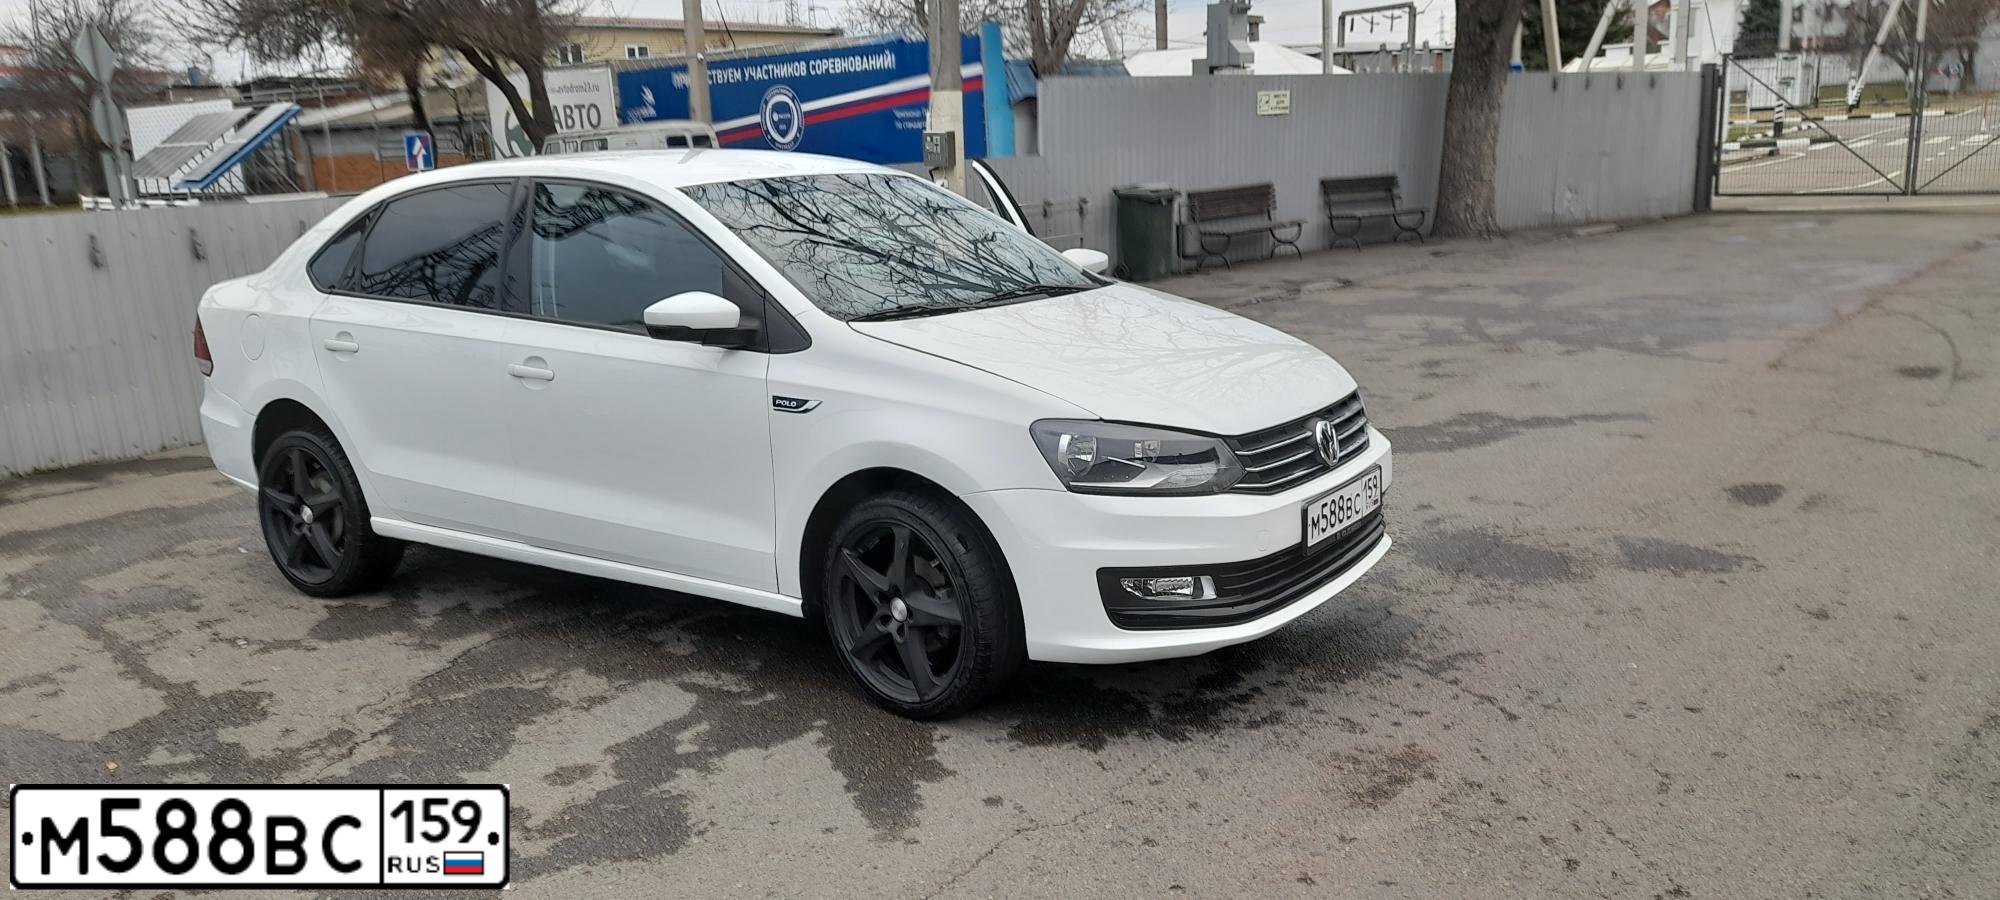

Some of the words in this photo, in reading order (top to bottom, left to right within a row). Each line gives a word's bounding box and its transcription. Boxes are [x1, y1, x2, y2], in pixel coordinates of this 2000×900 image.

[744, 62, 806, 82] УЧАСТНИКОВ
[809, 50, 896, 76] СОРЕВНОВАНИЙ!
[552, 103, 601, 130] АВТО
[775, 399, 797, 407] POLO
[1311, 493, 1361, 540] М588ВС
[1362, 475, 1378, 503] 159
